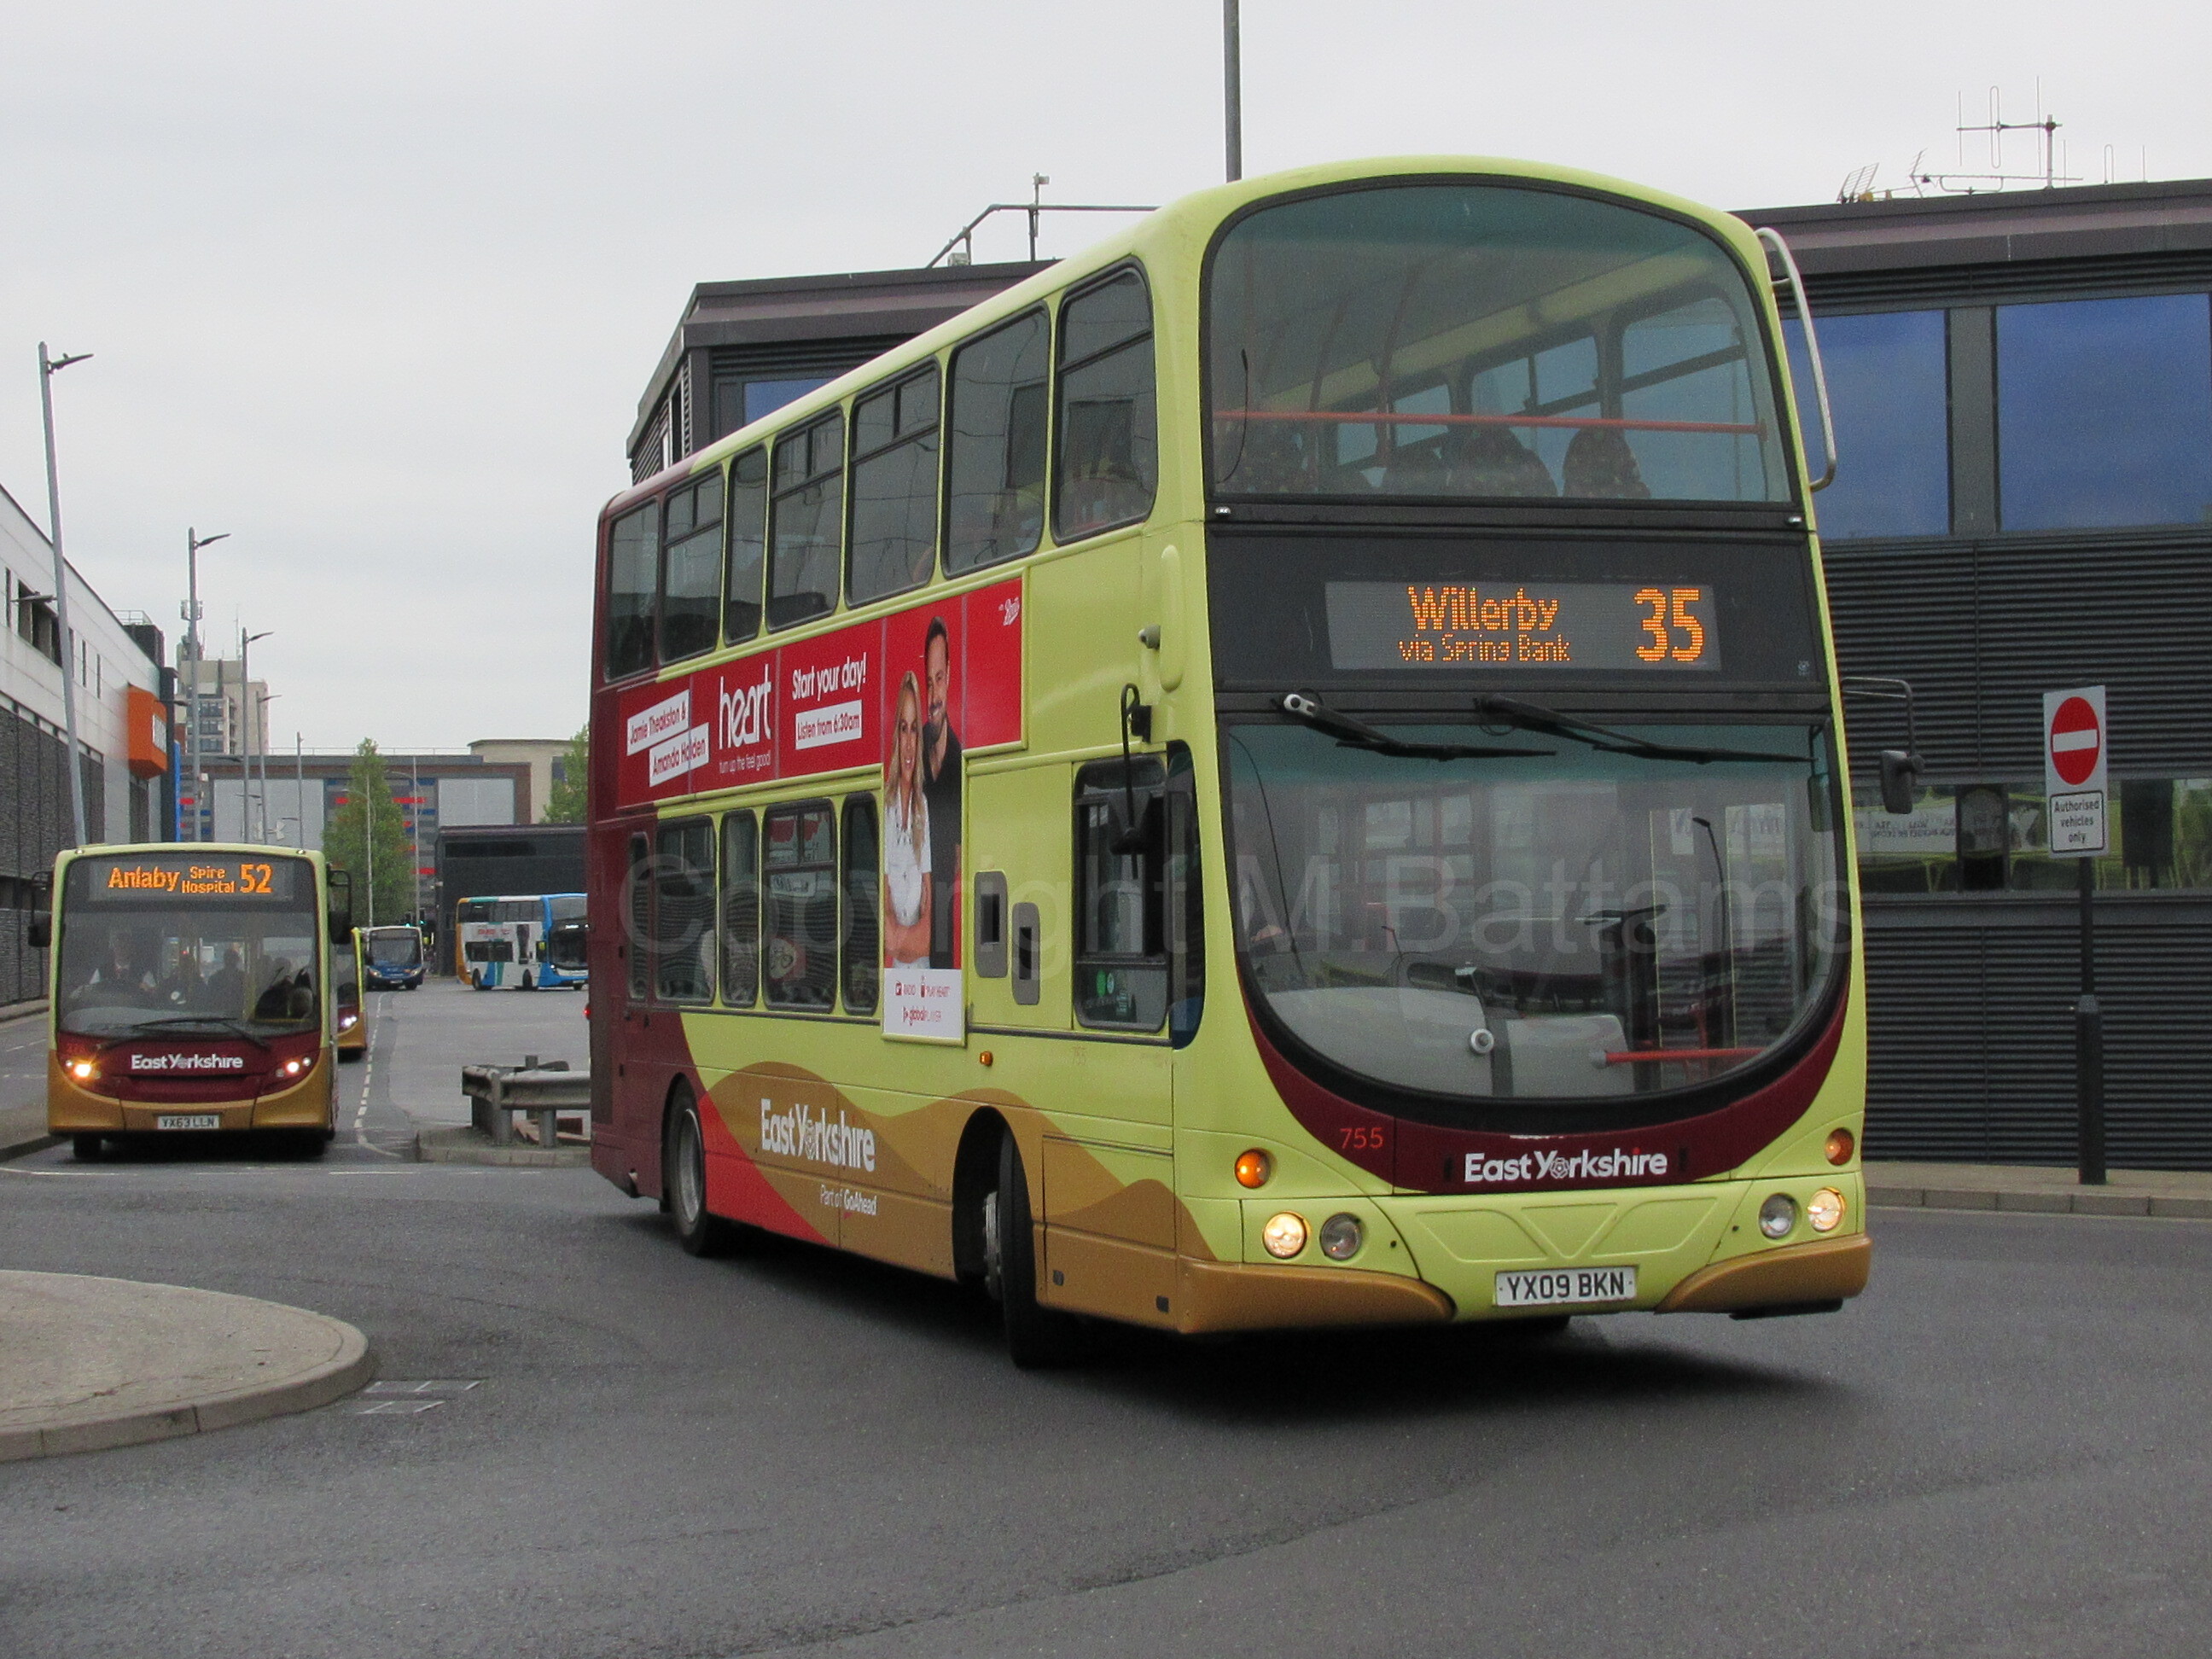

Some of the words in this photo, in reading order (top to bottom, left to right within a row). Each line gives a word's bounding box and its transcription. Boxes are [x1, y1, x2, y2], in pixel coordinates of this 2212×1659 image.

[1407, 585, 1560, 632] Willerby
[1633, 588, 1704, 662] 35
[1398, 634, 1435, 662] via
[1441, 634, 1511, 662] Spring
[1518, 634, 1572, 662] Bank
[792, 666, 815, 700] Start
[817, 666, 840, 701] your
[841, 652, 867, 693] day!
[719, 663, 771, 750] heart
[630, 719, 649, 745] Jamie
[798, 722, 817, 741] Listen
[818, 718, 834, 736] from
[652, 747, 681, 777] Amanda
[682, 736, 706, 762] Holden
[2054, 800, 2100, 812] Authorised
[2061, 815, 2094, 827] vehicles
[2068, 832, 2087, 843] only
[108, 866, 180, 892] Anlaby
[189, 865, 225, 880] Spire
[240, 864, 273, 894] 52
[181, 880, 236, 894] Hospital
[131, 1054, 168, 1069] East
[761, 1098, 795, 1156] East
[1340, 1127, 1383, 1150] 755
[1464, 1153, 1532, 1182] East
[820, 1184, 835, 1206] Part
[1507, 1274, 1570, 1301] YX09
[1578, 1272, 1625, 1297] BKN
